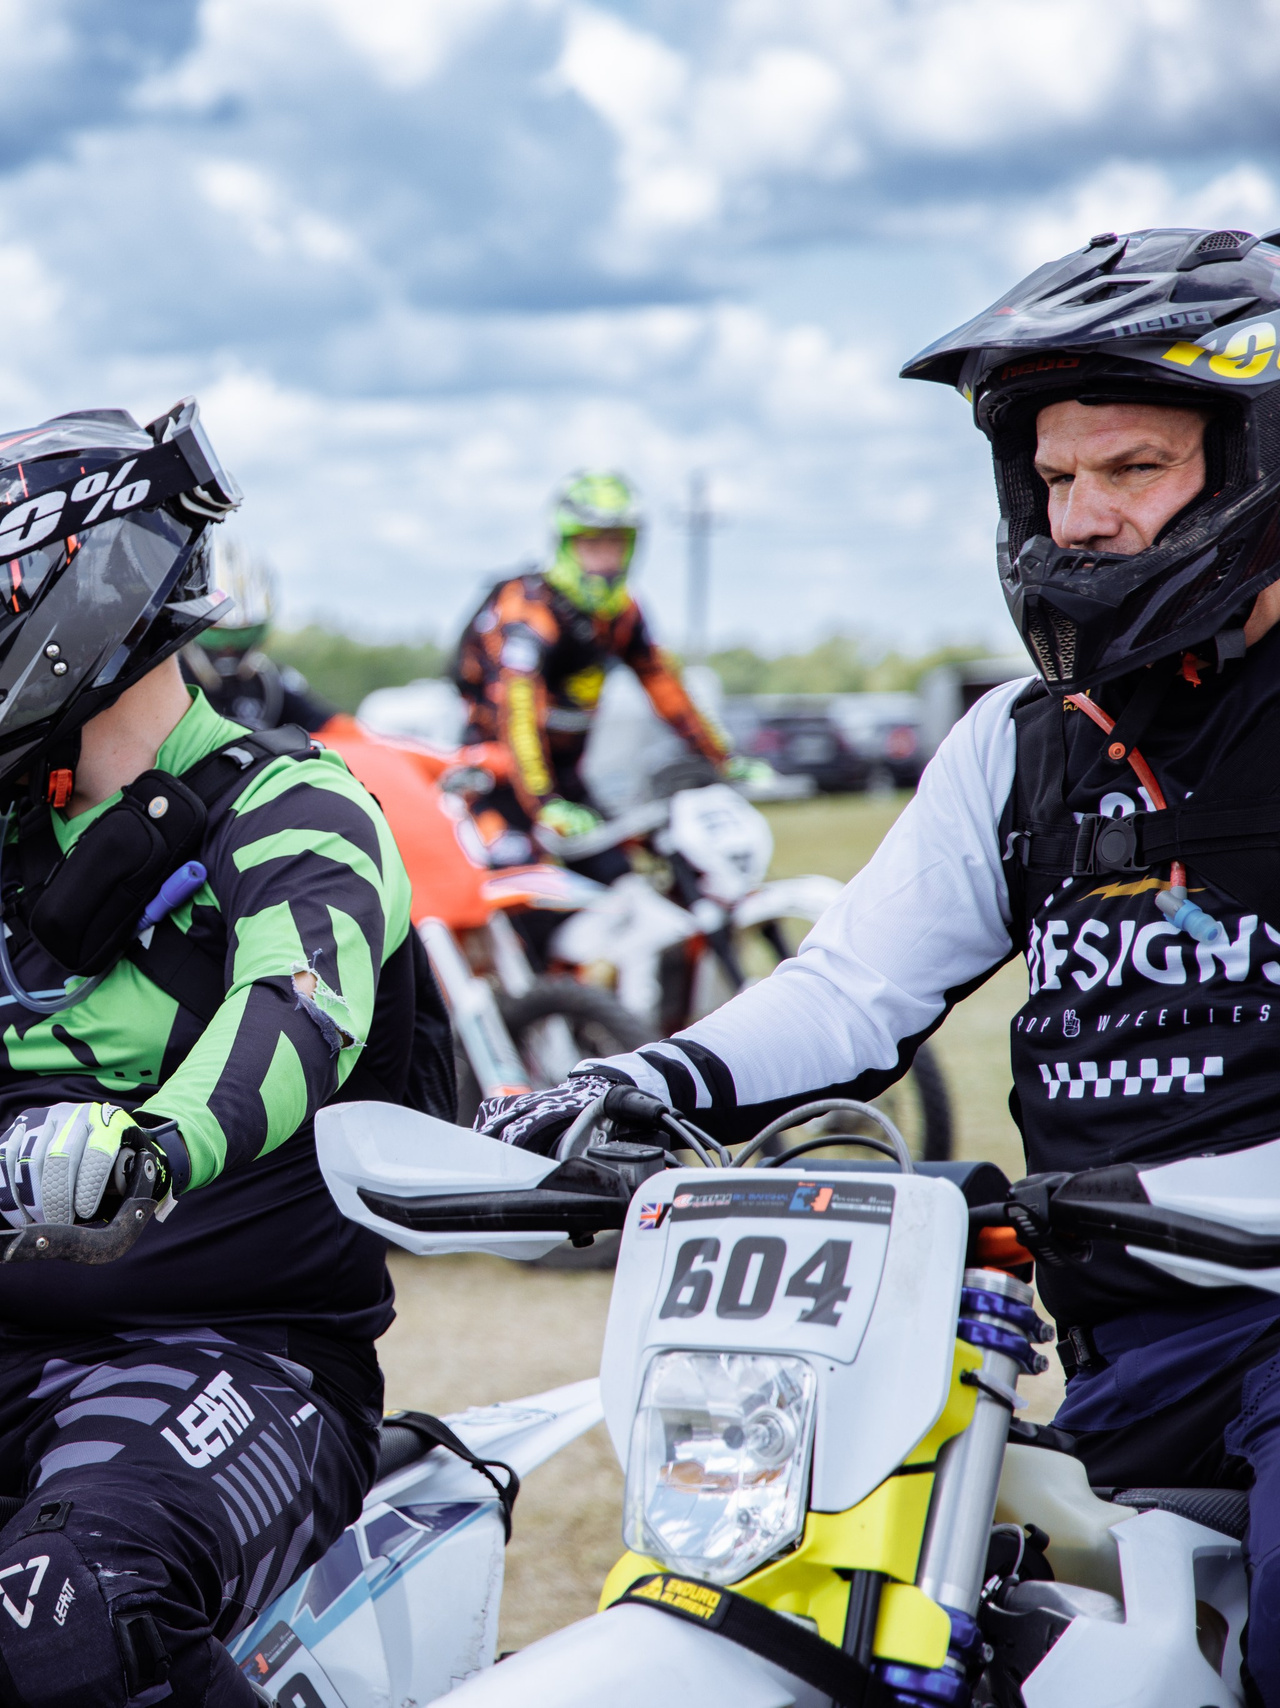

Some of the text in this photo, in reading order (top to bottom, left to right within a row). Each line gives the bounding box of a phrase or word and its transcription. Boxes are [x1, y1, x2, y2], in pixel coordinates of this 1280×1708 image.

[1097, 1004, 1271, 1032] WHEELIES
[658, 1236, 853, 1327] 604
[160, 1370, 255, 1468] LEATT
[53, 1577, 77, 1627] LEATT
[660, 1591, 716, 1620] ELEMENT
[664, 1578, 722, 1610] ENDURO
